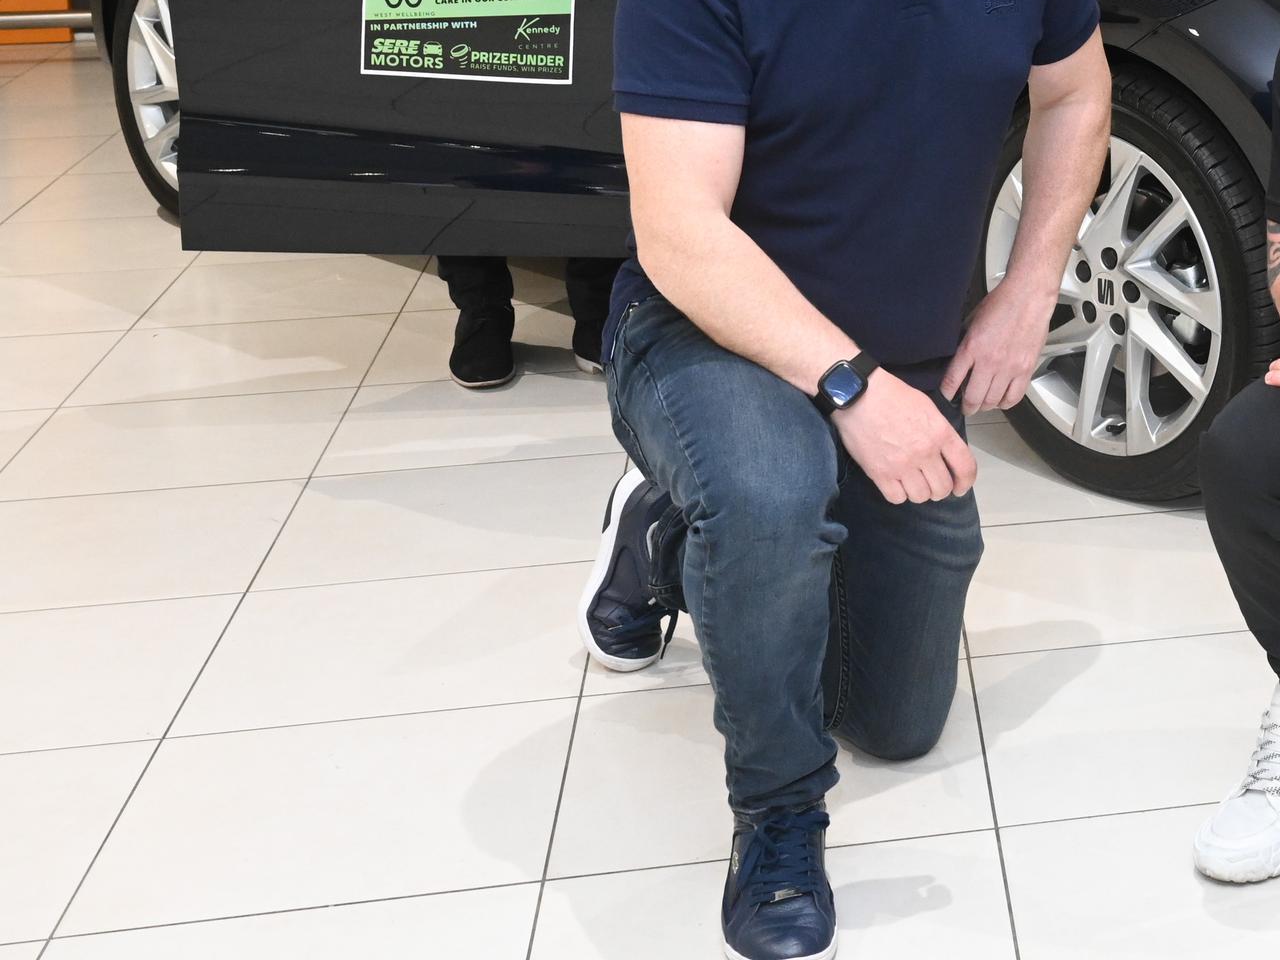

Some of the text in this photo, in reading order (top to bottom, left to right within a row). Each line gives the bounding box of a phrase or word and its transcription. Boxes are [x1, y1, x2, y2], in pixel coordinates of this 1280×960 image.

[370, 21, 477, 31] IN PARTNERSHIP WITH
[514, 17, 561, 41] Kennedy
[371, 38, 421, 55] SERE
[371, 54, 443, 69] MOTORS
[471, 51, 564, 67] PRIZEFUNDER
[470, 63, 490, 71] RAISE
[538, 66, 563, 74] PRIZES
